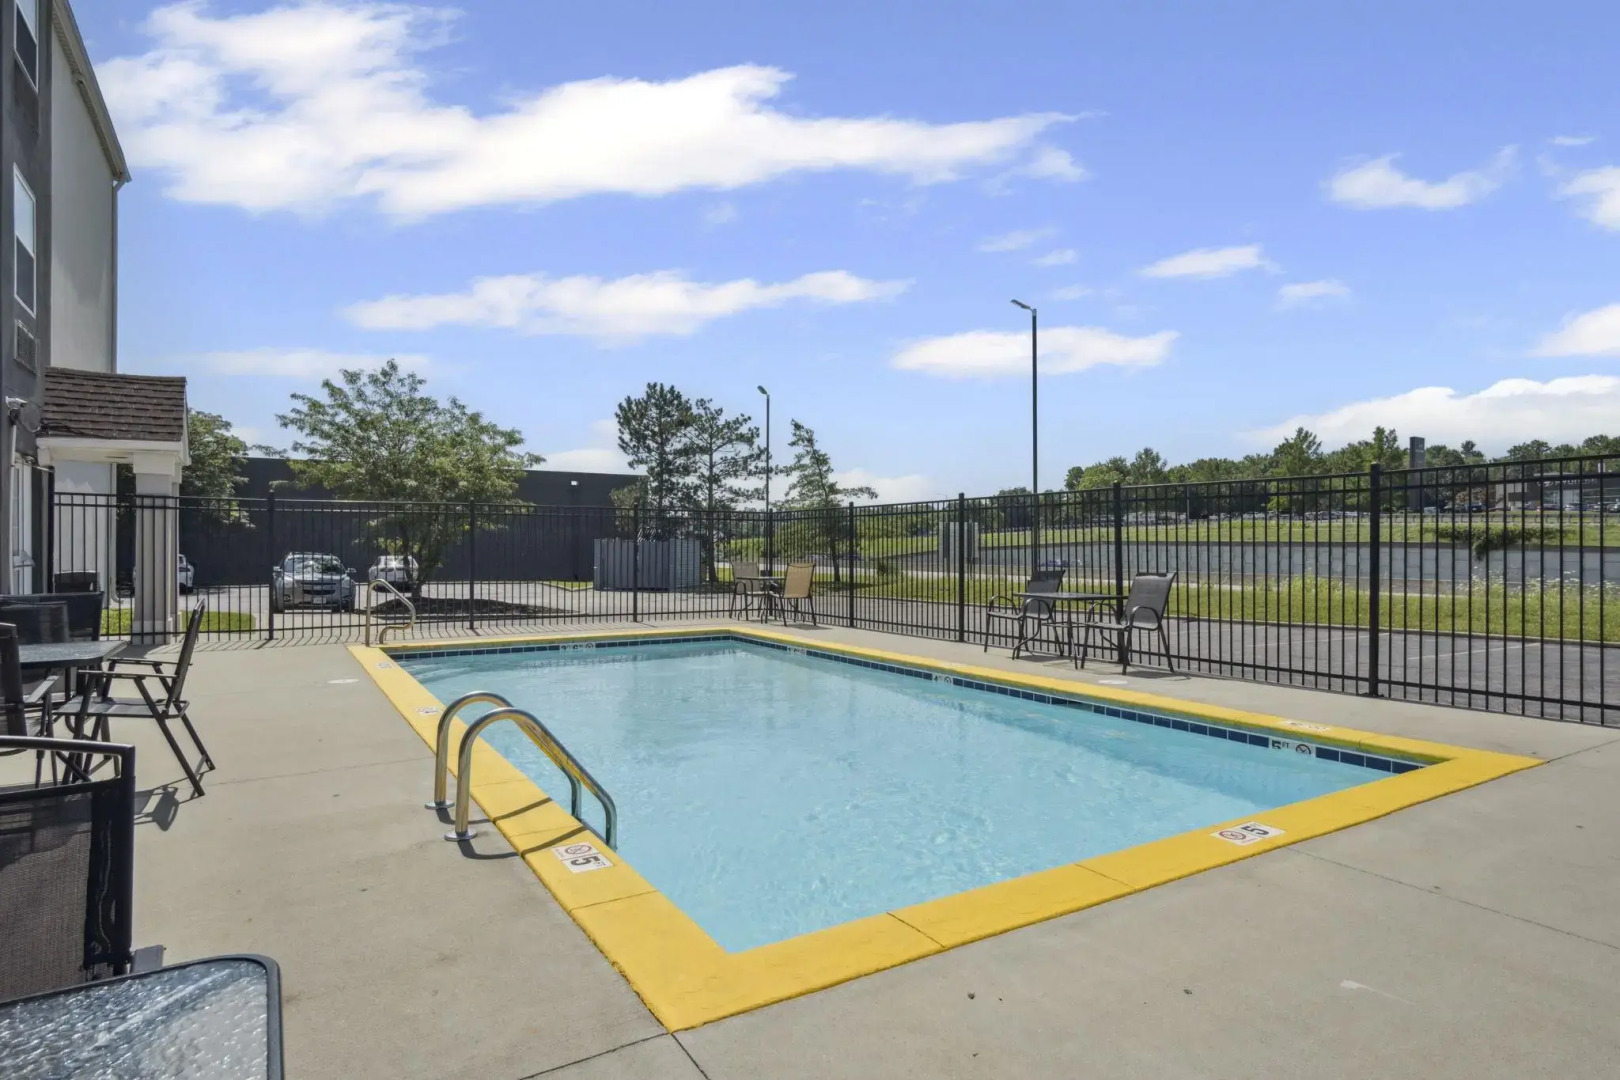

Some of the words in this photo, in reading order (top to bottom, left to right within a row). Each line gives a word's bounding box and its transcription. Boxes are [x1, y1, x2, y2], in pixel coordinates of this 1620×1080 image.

[1272, 740, 1281, 749] 5
[1240, 825, 1269, 835] 5
[570, 856, 600, 866] 5
